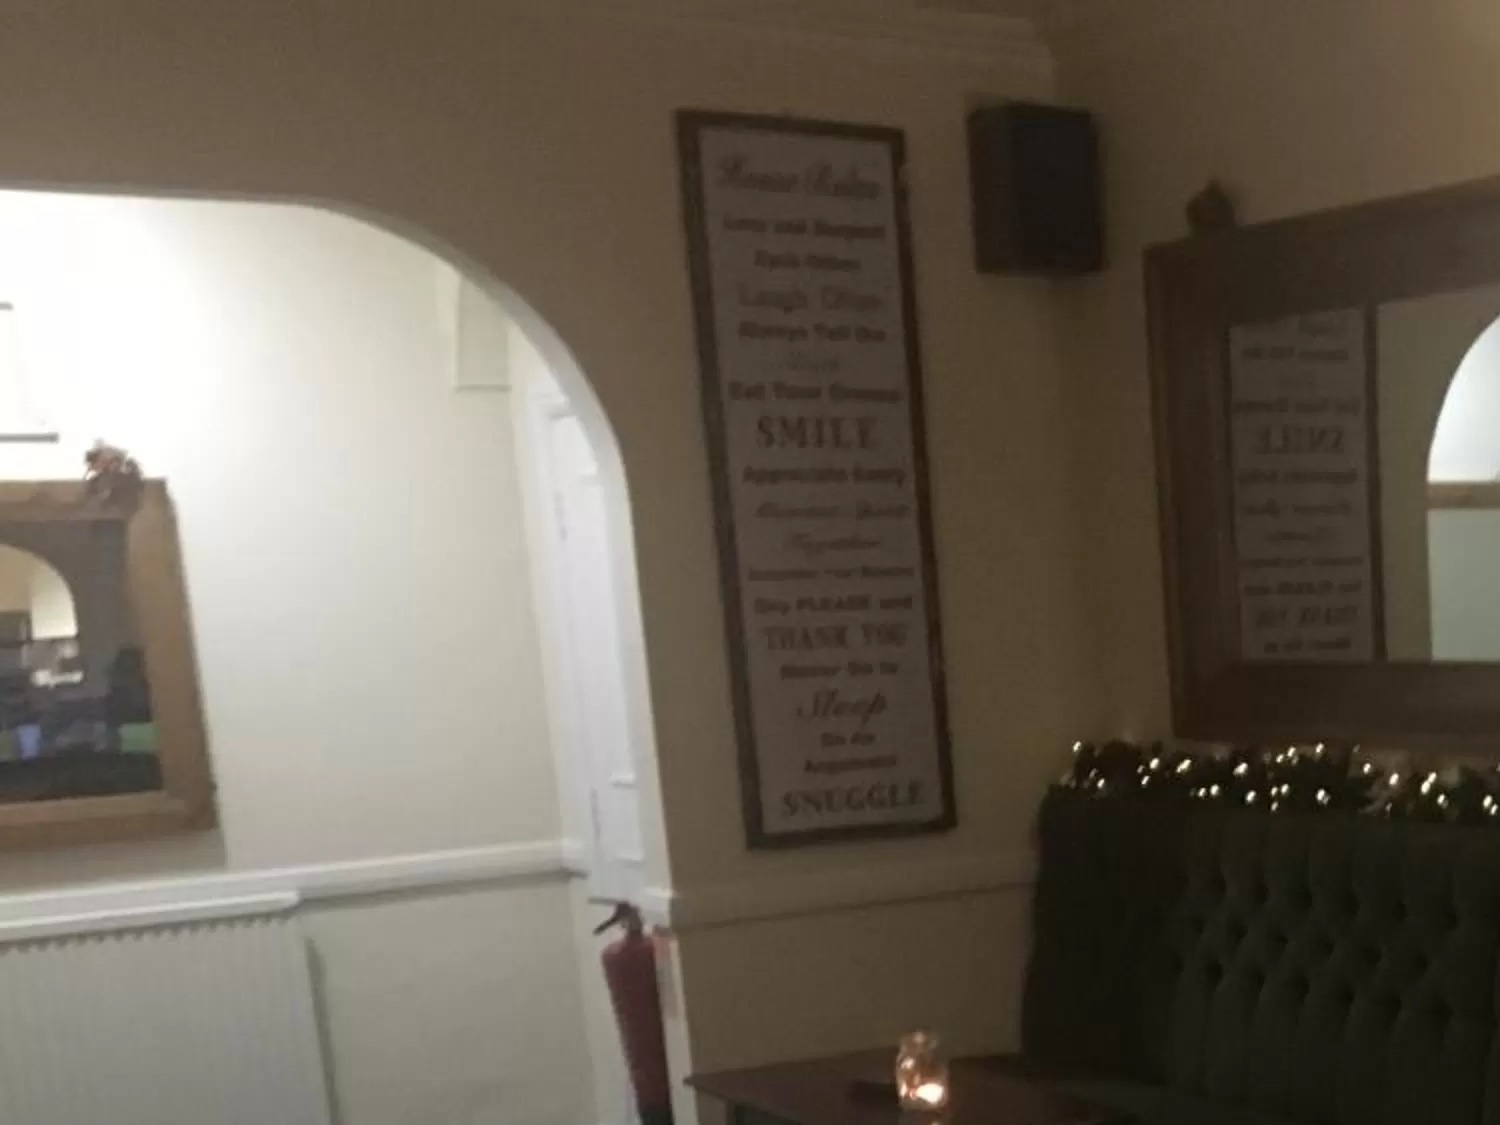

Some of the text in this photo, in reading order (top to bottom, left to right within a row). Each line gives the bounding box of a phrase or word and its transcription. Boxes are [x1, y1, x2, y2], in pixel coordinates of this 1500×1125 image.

[757, 415, 879, 449] SMILE
[764, 622, 908, 651] THANK YOU
[782, 779, 926, 817] SNUGGLE
